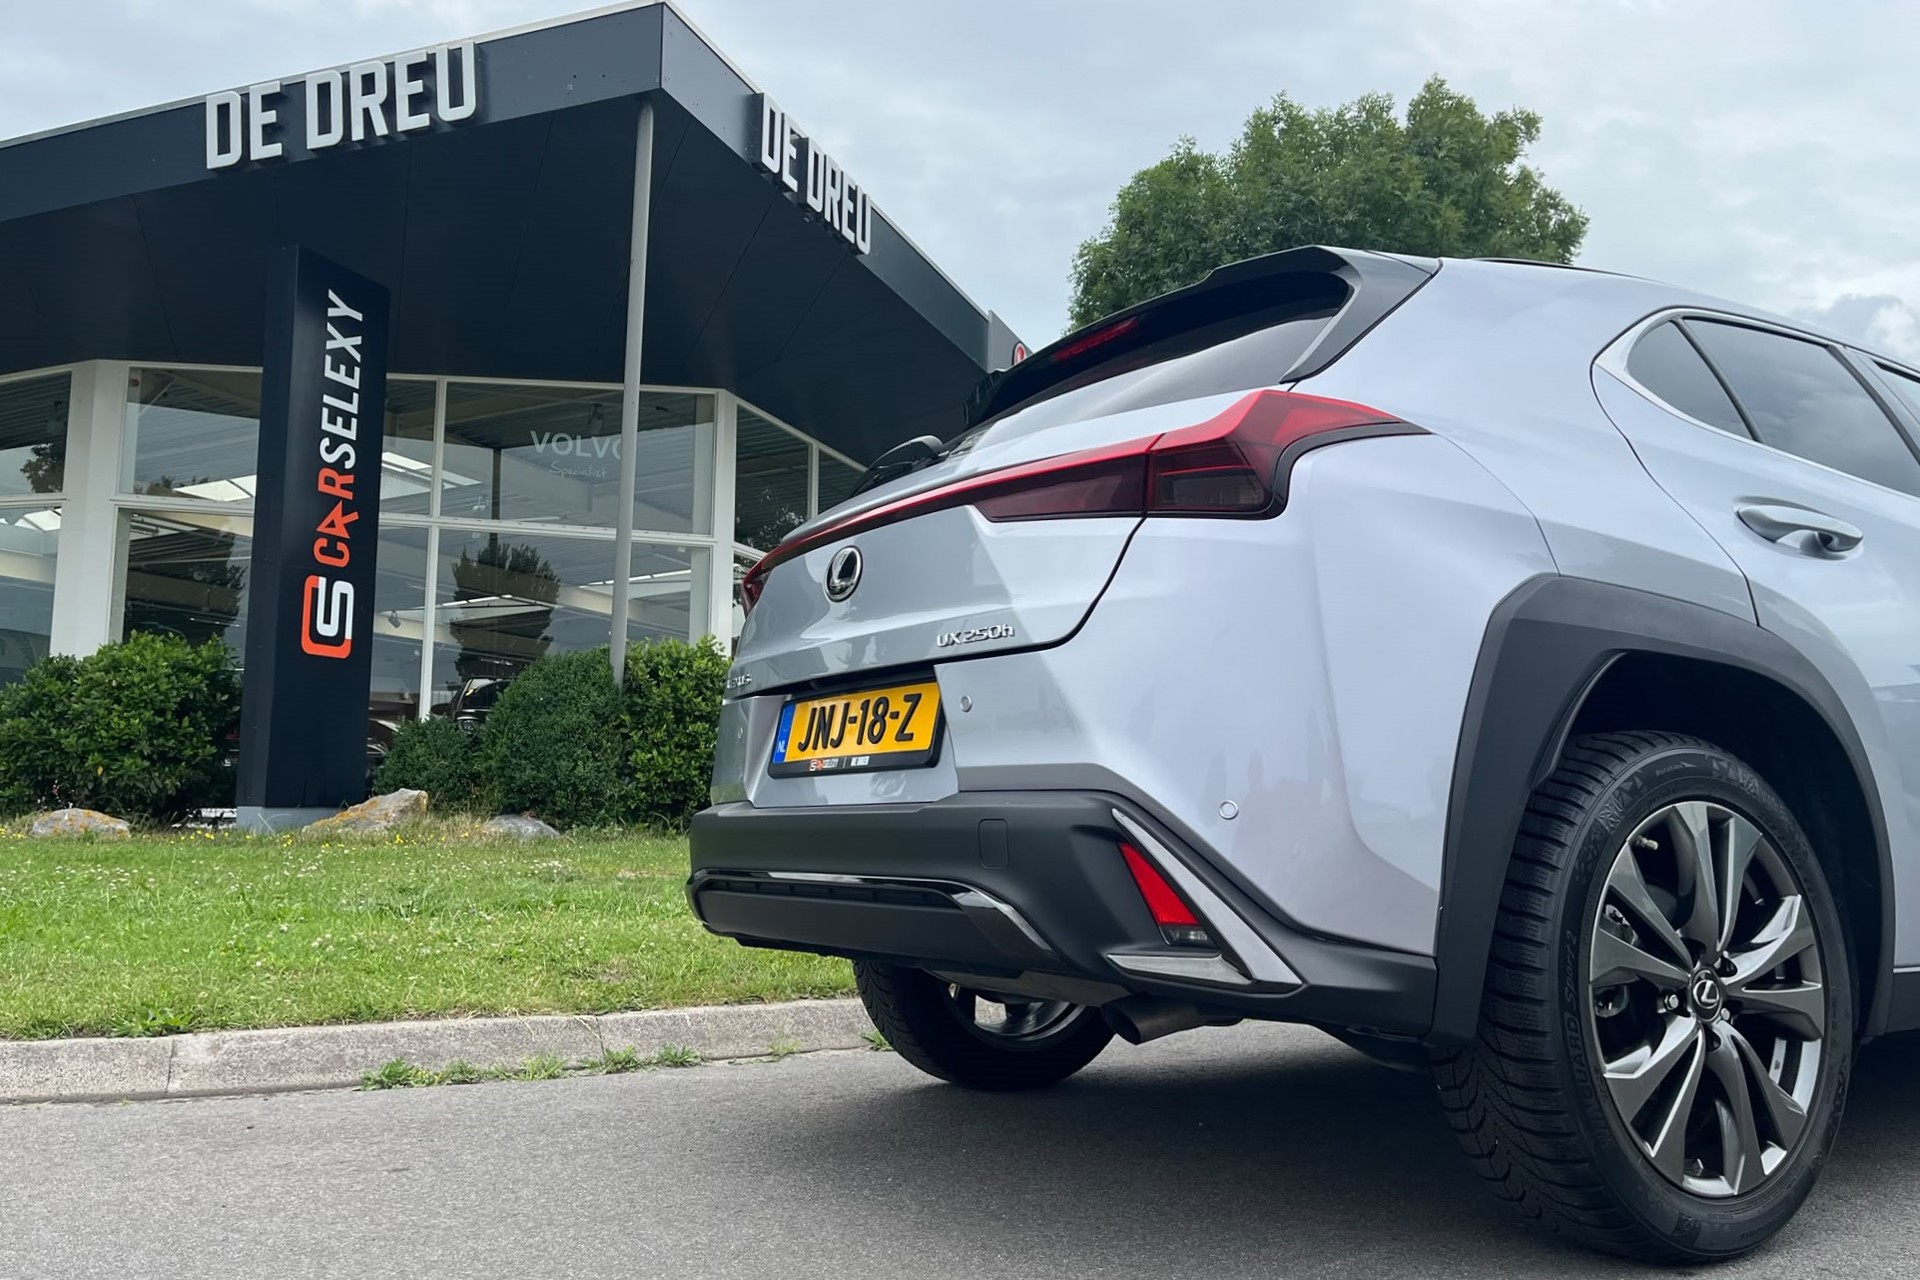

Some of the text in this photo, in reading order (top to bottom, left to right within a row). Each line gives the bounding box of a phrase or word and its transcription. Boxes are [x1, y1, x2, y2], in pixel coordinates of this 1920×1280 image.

[206, 40, 478, 170] DE DREU
[760, 92, 873, 256] DE DREU
[797, 692, 923, 752] JNJ-18-Z
